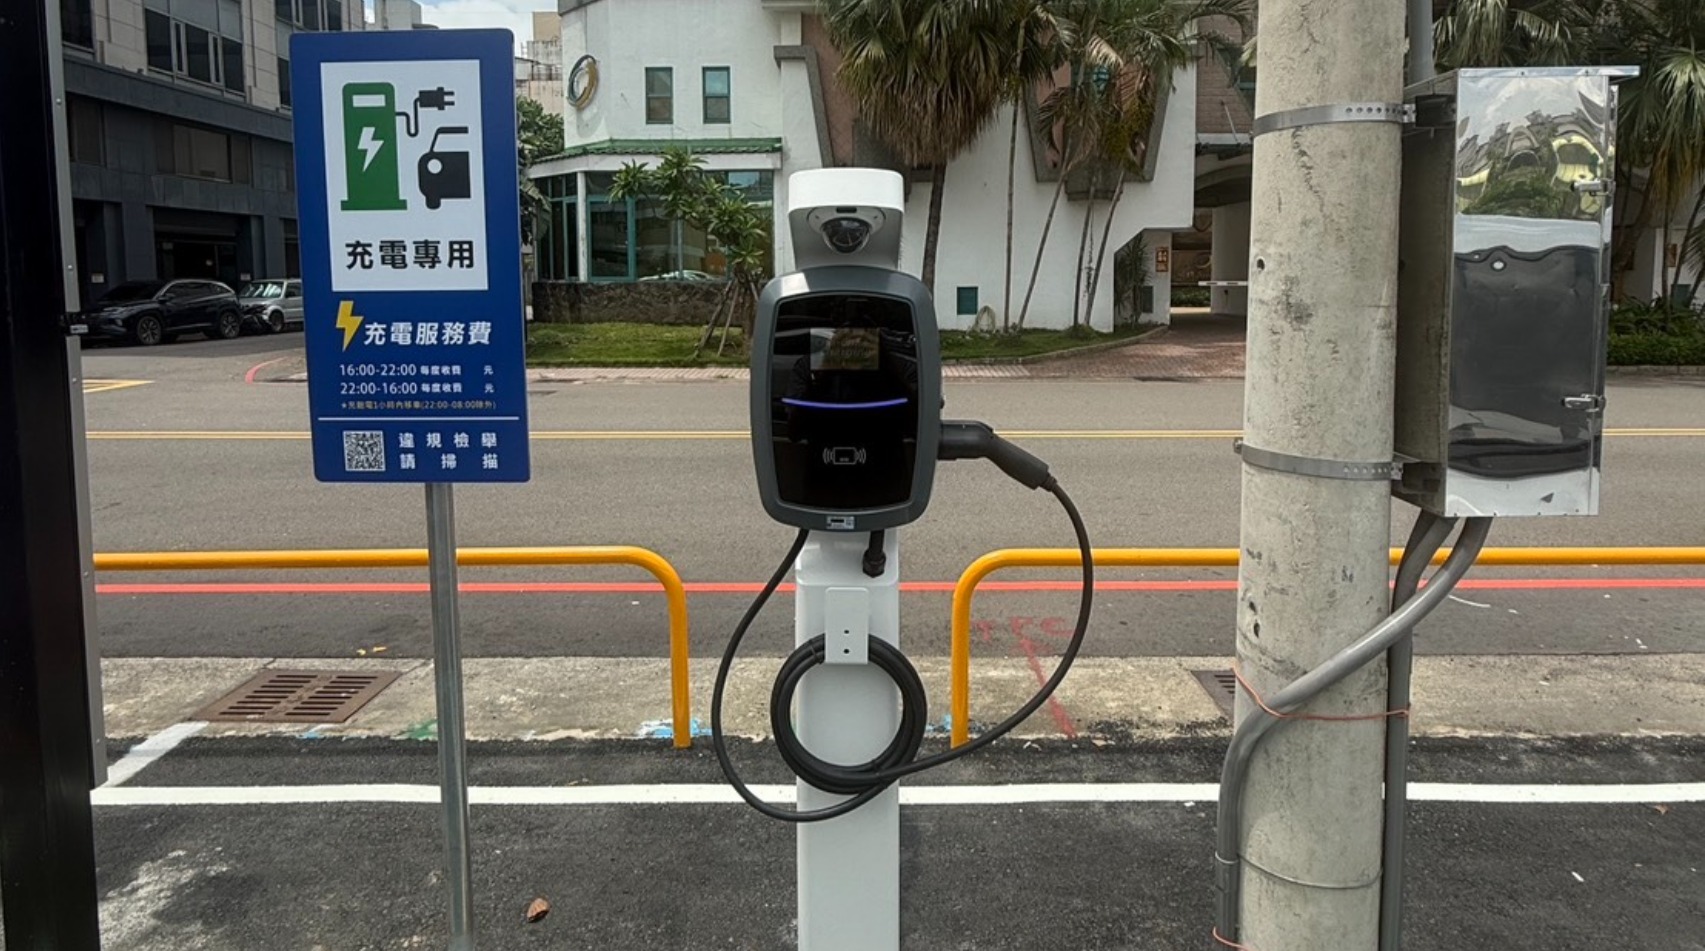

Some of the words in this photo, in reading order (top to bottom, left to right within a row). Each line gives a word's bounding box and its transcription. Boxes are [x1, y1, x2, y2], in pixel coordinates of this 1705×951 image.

[345, 239, 474, 269] 充電專用
[363, 320, 492, 346] 充電服務費
[339, 363, 417, 376] 16:00-22:00
[420, 365, 462, 376] 每度收費
[483, 365, 494, 376] 元
[340, 382, 418, 395] 22:00-16:00
[421, 383, 463, 393] 每度收費
[484, 383, 495, 394] 元
[398, 432, 498, 448] 違規檢舉
[400, 453, 499, 469] 請掃描
